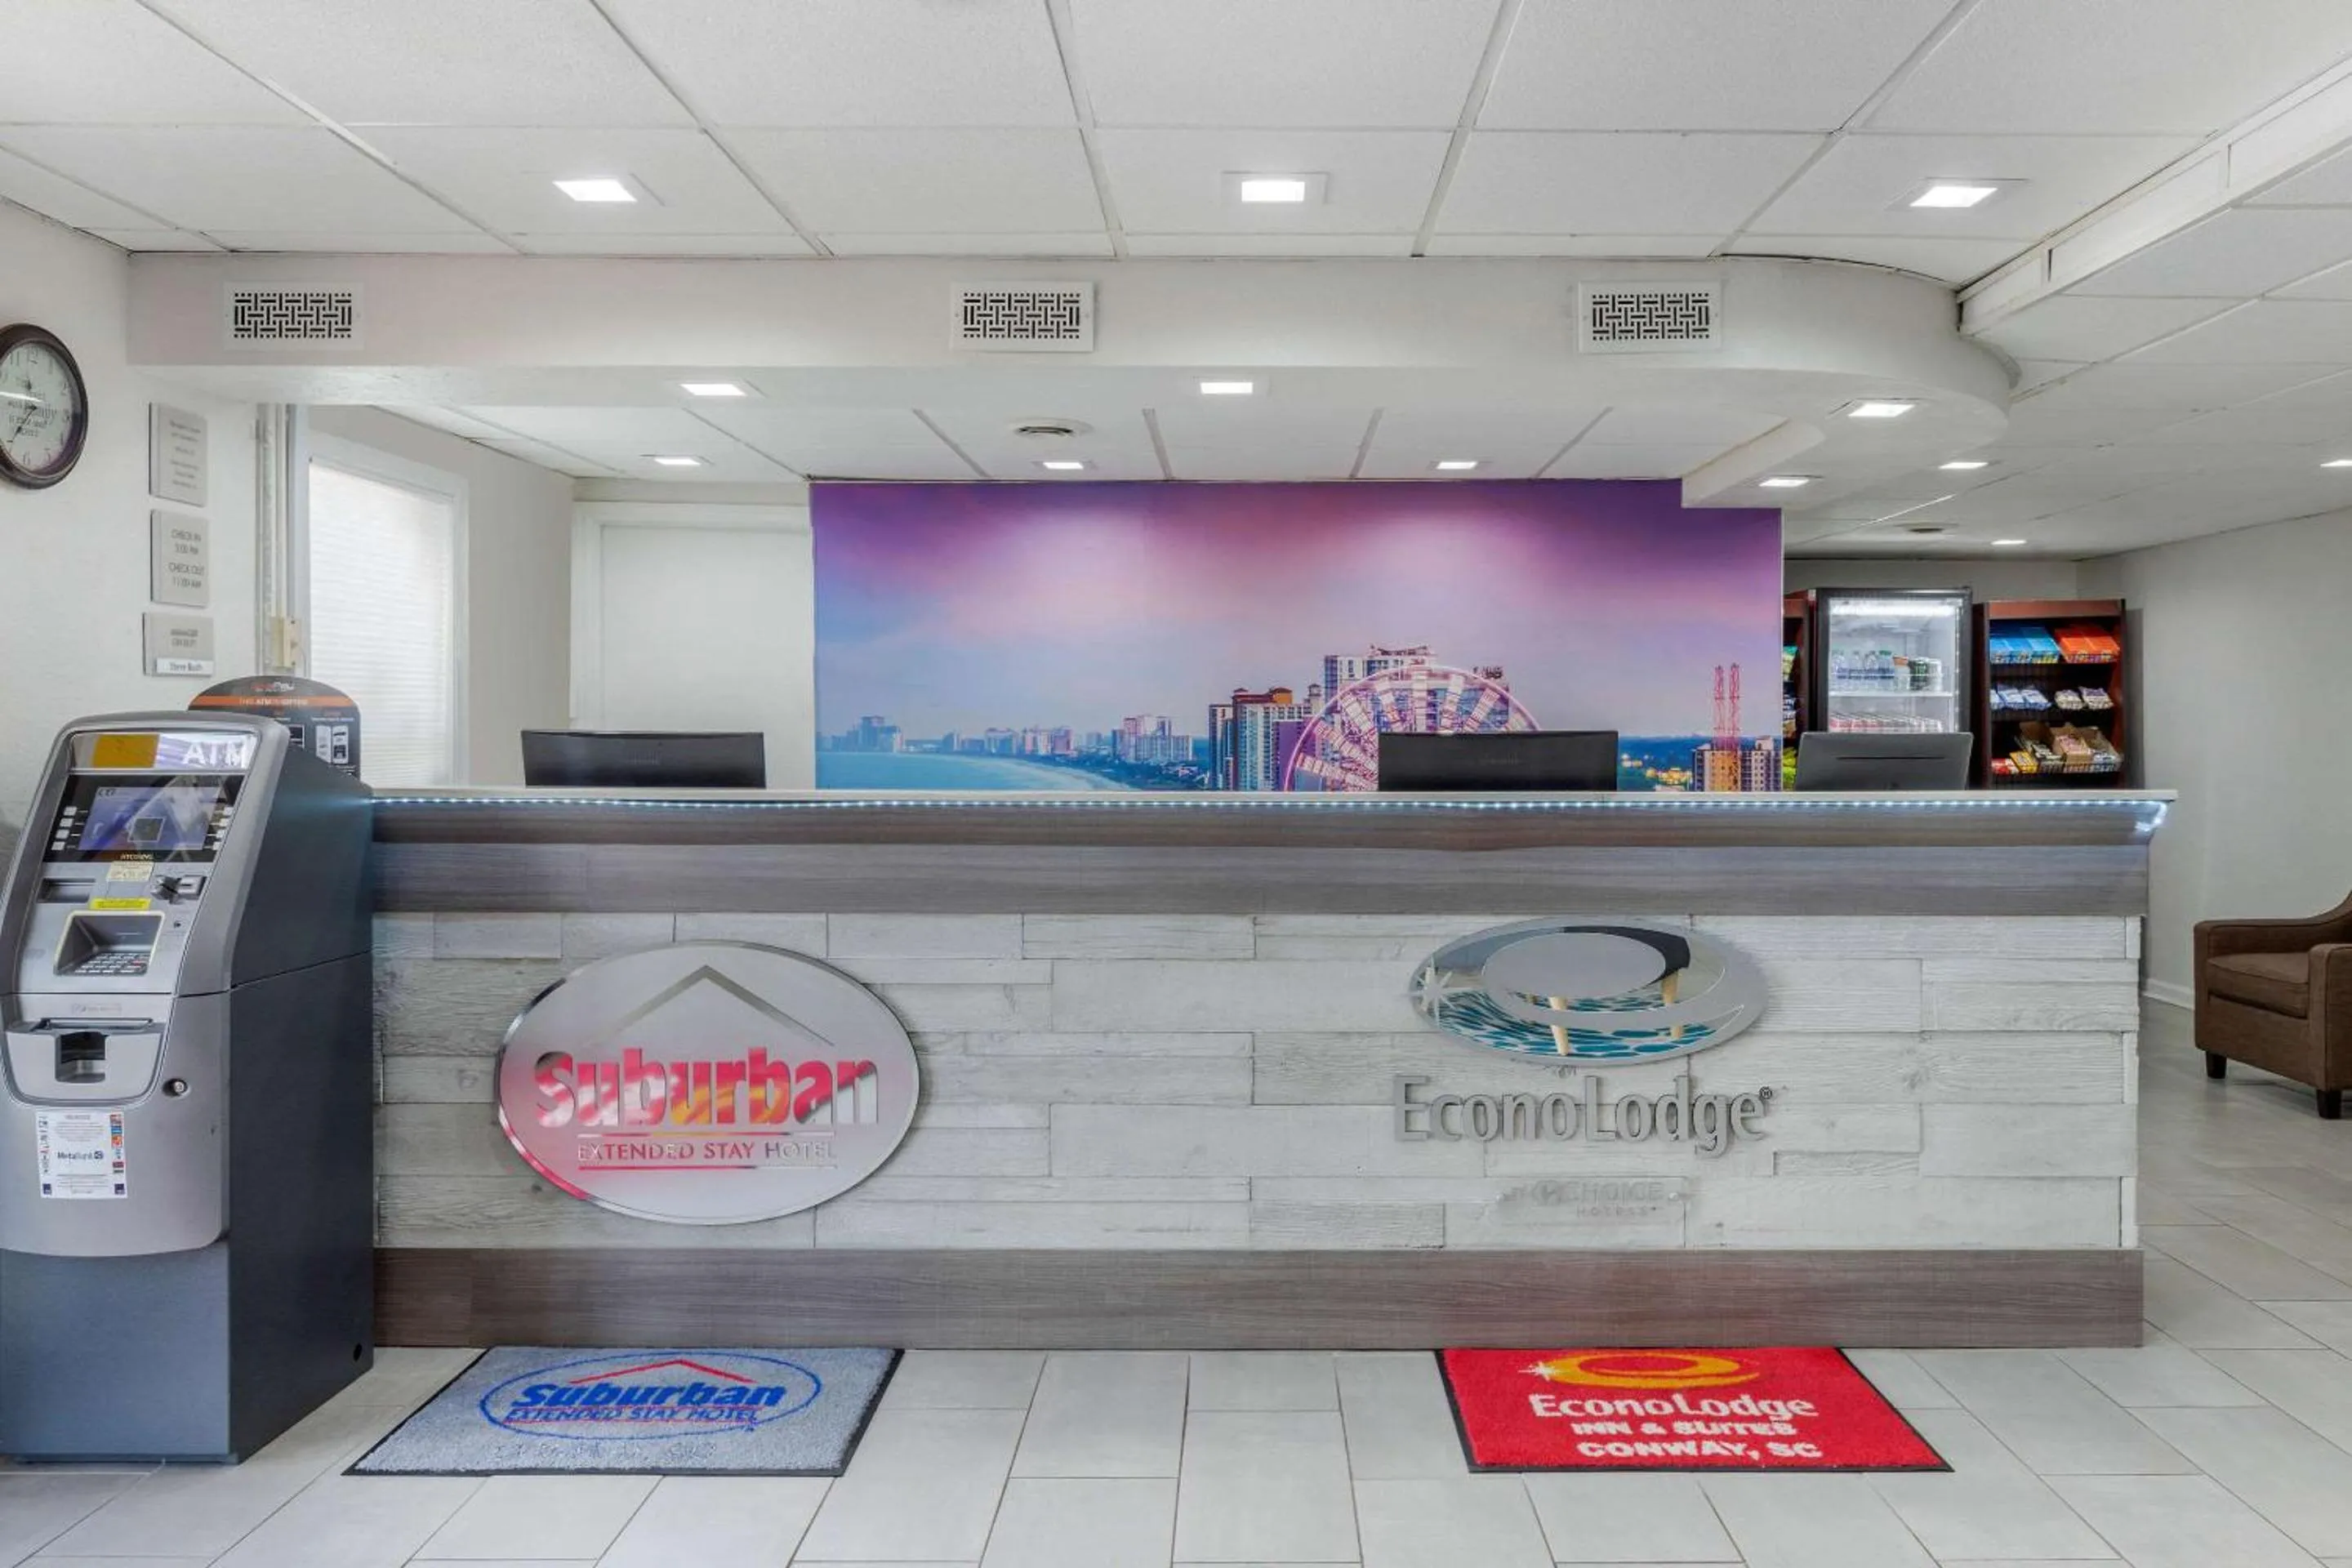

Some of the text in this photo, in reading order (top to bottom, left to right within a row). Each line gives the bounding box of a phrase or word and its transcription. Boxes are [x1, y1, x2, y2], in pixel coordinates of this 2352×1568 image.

[182, 742, 248, 768] ATM
[535, 1047, 879, 1128] Suburban
[577, 1143, 838, 1160] EXTENDED STAY HOTEL
[510, 1382, 788, 1407] Suburban
[506, 1408, 759, 1421] EXTENDED STAY HOTEL
[1528, 1392, 1820, 1421] EconoLodge
[1570, 1420, 1797, 1436] INN & SUITES
[1576, 1439, 1824, 1461] CONWAY, SC
